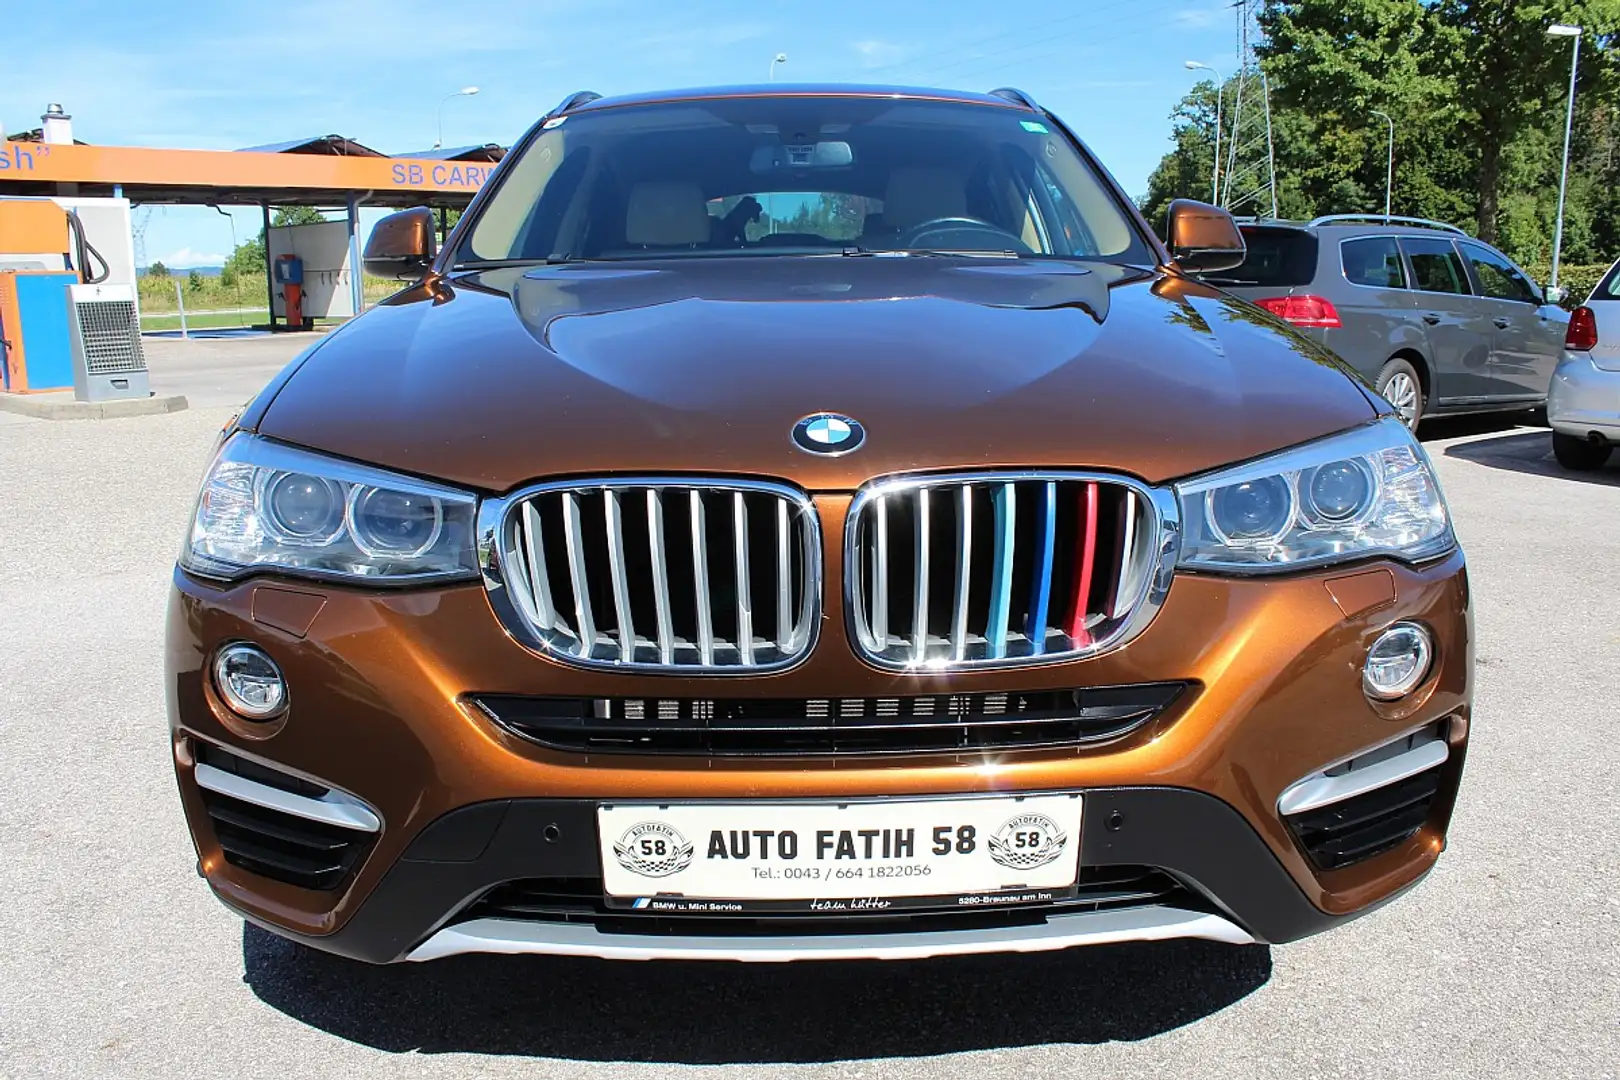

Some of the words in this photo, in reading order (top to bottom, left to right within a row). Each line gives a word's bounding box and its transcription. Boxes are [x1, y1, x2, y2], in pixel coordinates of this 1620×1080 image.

[392, 164, 424, 185] SB
[641, 839, 667, 856] 58
[707, 830, 798, 860] AUTO
[816, 828, 915, 860] FATIH
[931, 825, 976, 856] 58
[1015, 832, 1040, 848] 58
[752, 866, 781, 879] Tel.:
[784, 867, 820, 880] 0043
[824, 868, 832, 882] /
[835, 866, 864, 879] 664
[868, 864, 932, 878] 1822056
[1038, 892, 1052, 900] Inn
[652, 902, 676, 910] BMW
[709, 903, 743, 911] Service
[810, 899, 847, 910] team
